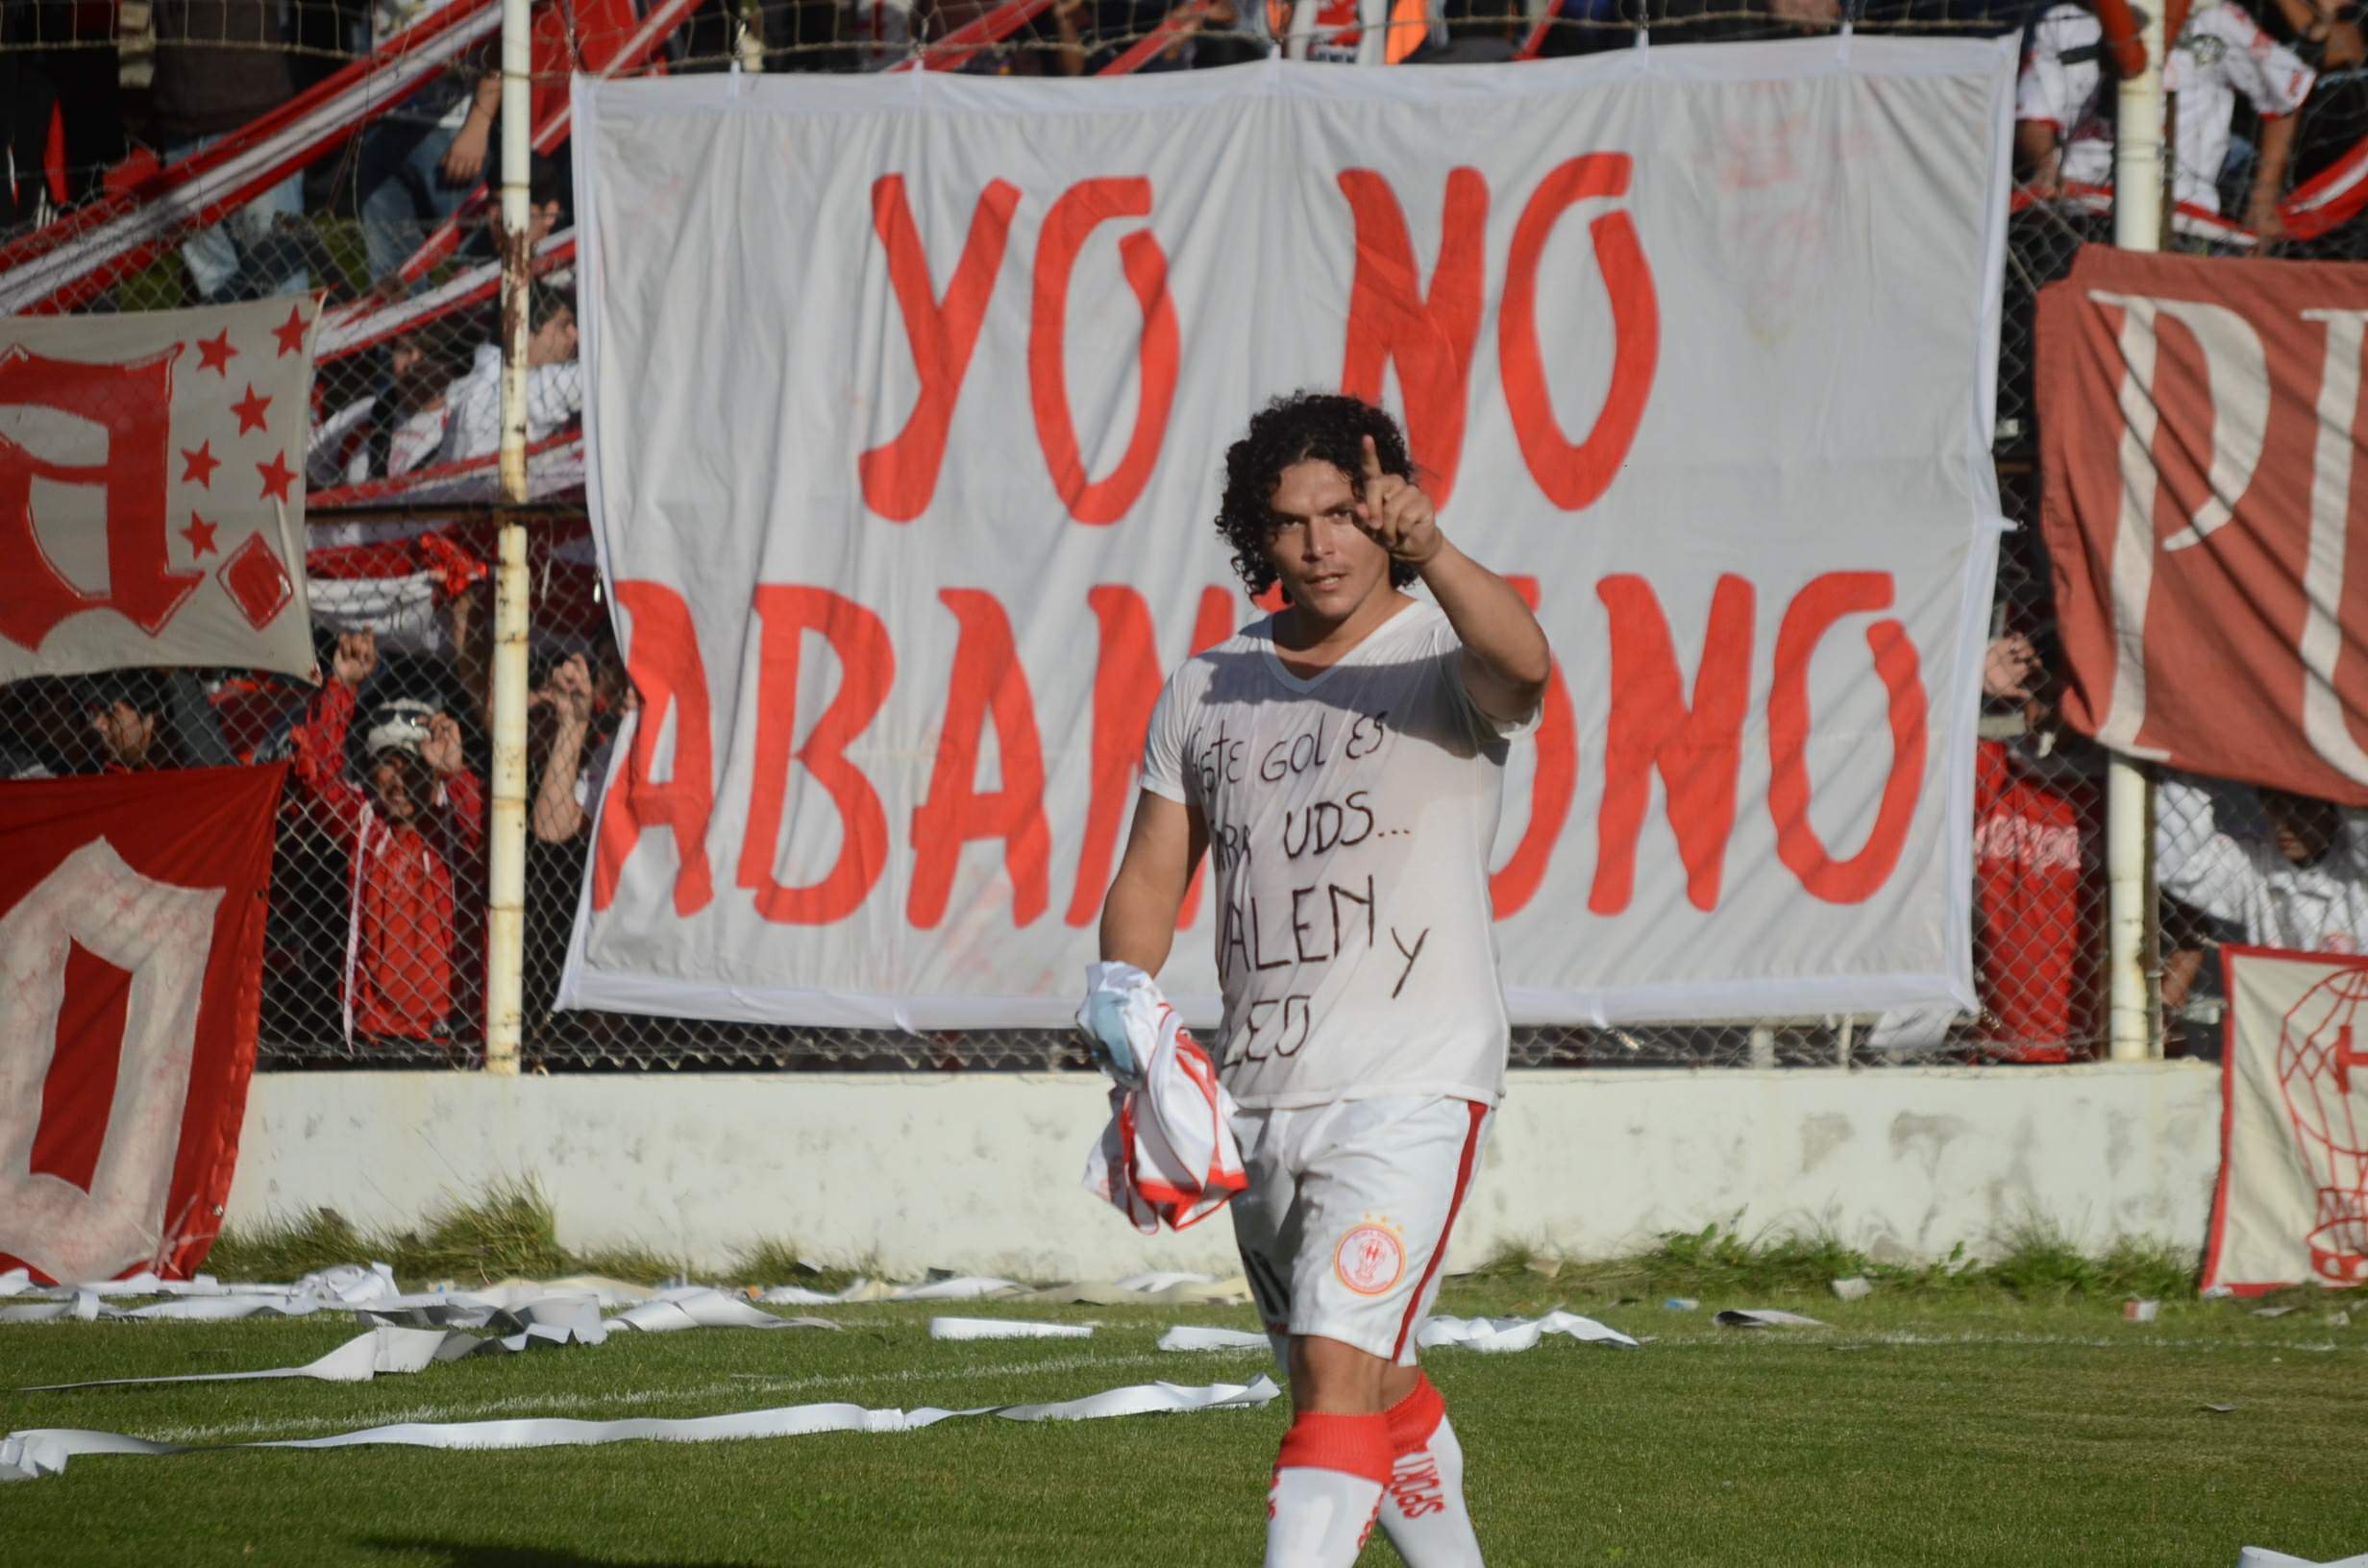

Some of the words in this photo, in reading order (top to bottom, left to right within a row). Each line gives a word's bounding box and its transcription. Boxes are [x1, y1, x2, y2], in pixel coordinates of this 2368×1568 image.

[858, 172, 1180, 527] YO
[1336, 151, 1661, 512] NO
[1261, 712, 1327, 783] GOL
[1346, 711, 1390, 760] ES
